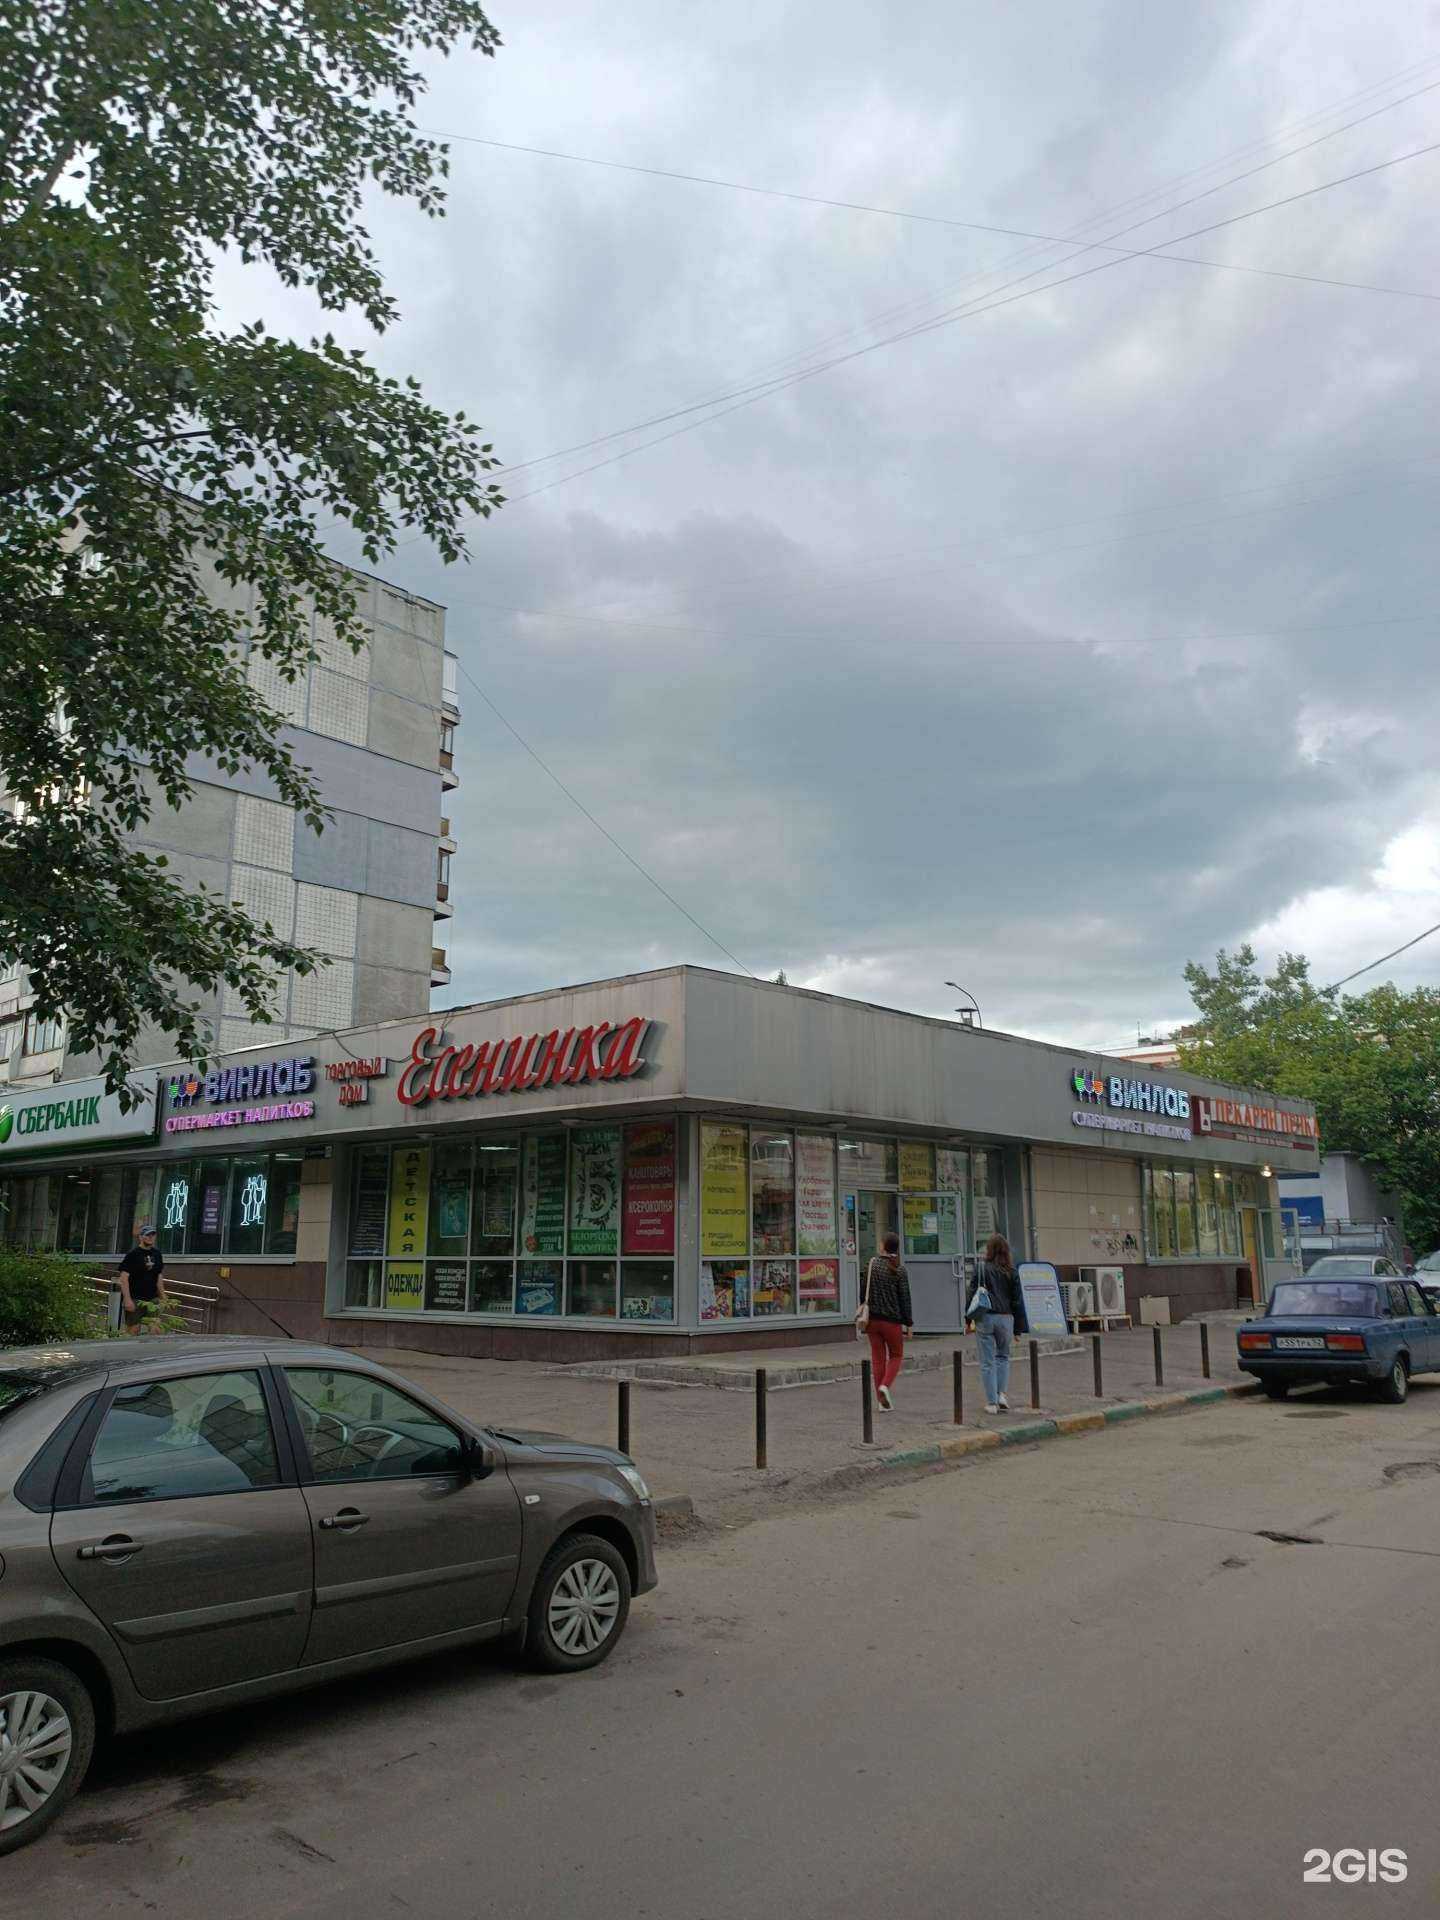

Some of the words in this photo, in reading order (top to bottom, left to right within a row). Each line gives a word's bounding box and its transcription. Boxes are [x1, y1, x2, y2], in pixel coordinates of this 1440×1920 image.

[205, 1056, 314, 1102] ВИНЛАБ
[325, 1057, 384, 1081] ТОРГОВЫЙ
[397, 1017, 652, 1106] Есенинка
[338, 1082, 366, 1106] ДОМ
[1108, 1076, 1190, 1119] ВИНЛАБ
[16, 1095, 101, 1135] СБЕРБАНК
[166, 1109, 242, 1133] СУПЕРМАРКЕТ
[244, 1101, 314, 1123] НАПИТКОВ
[1072, 1111, 1144, 1134] СУПЕРМАРКЕТ
[402, 1152, 421, 1252] ДЕТСКАЯ
